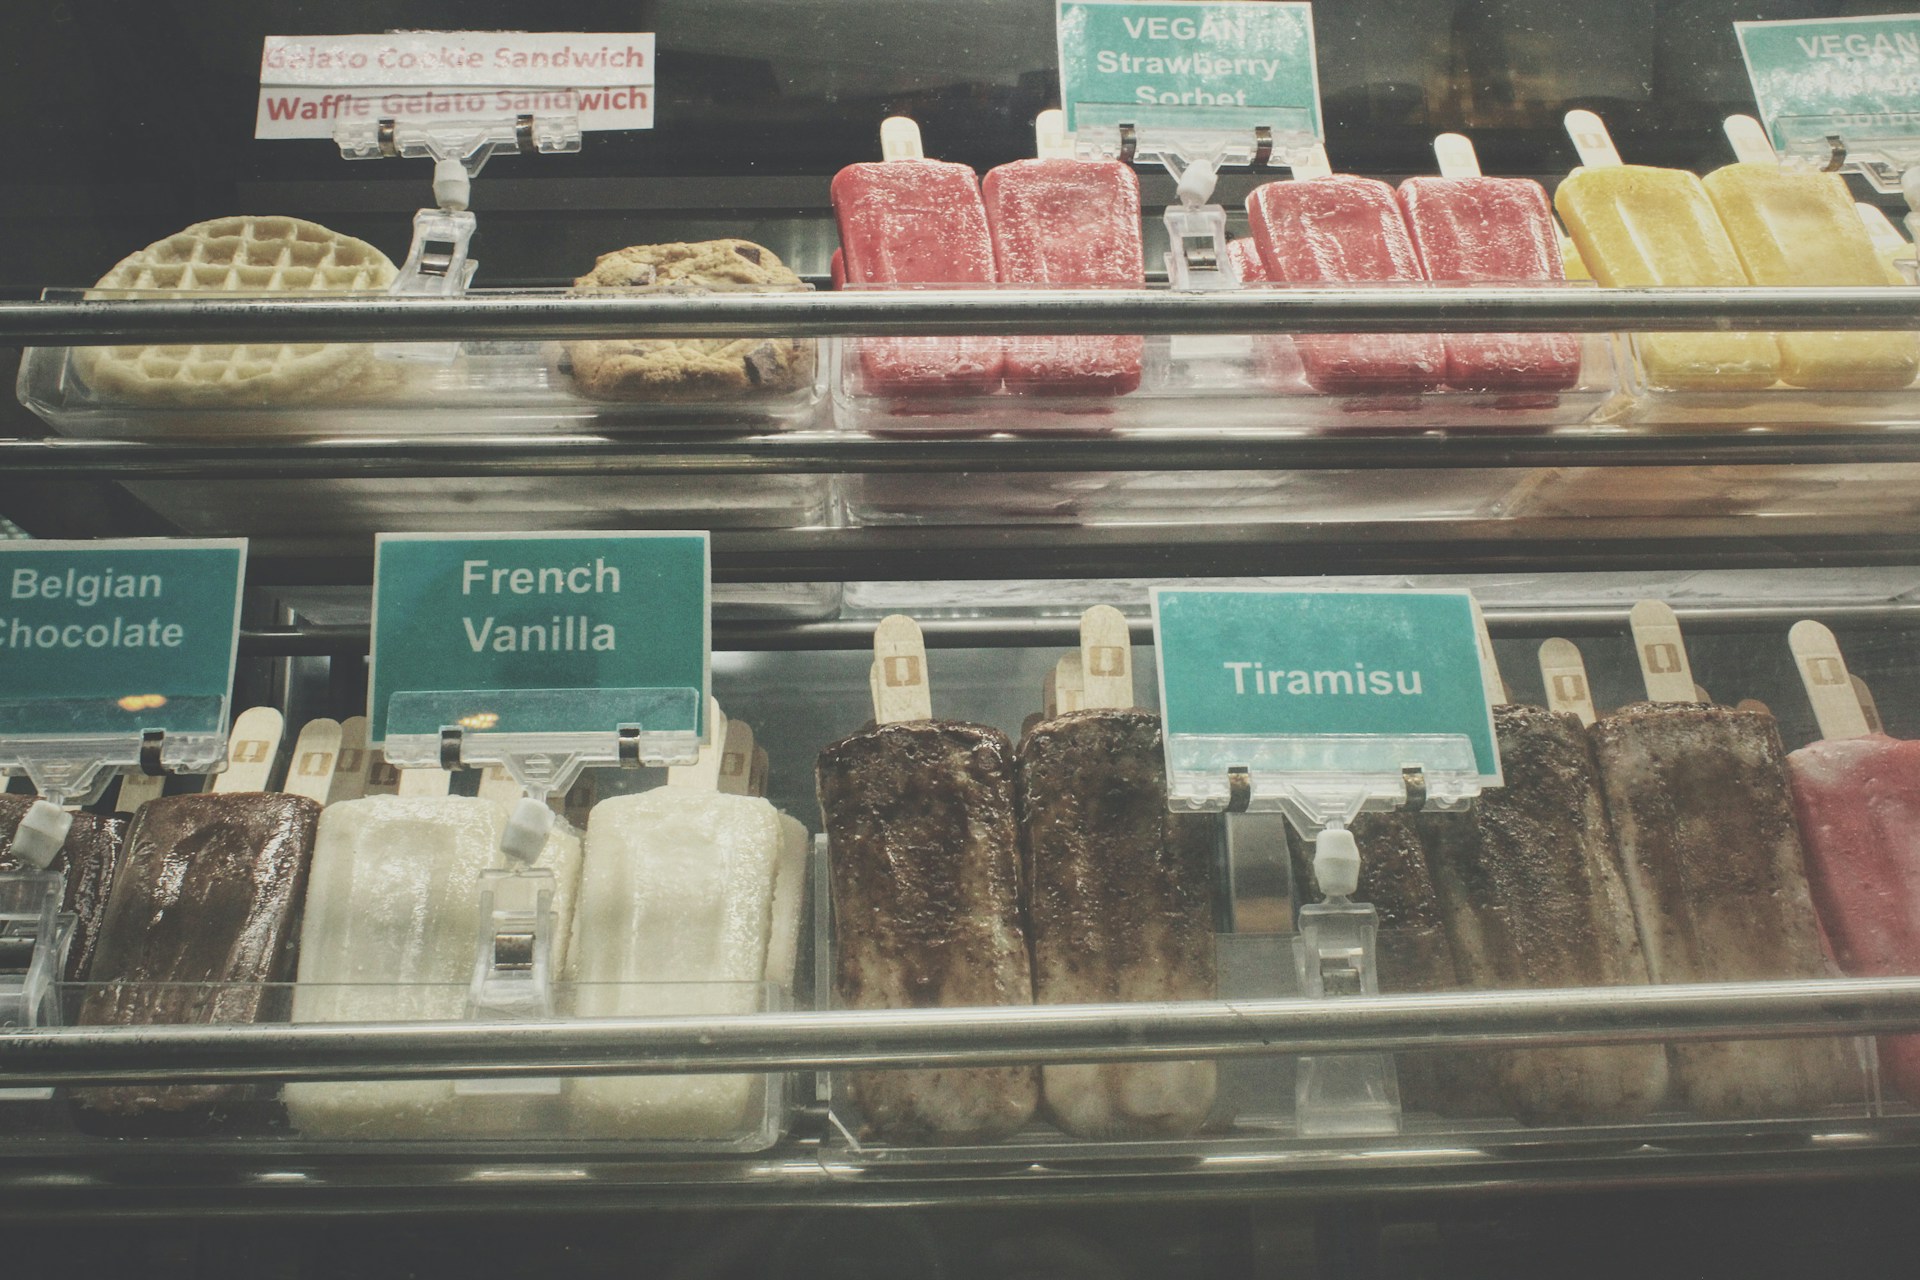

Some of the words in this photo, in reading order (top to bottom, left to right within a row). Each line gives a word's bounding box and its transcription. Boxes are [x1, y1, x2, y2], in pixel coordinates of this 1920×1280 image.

[1123, 17, 1247, 40] VEGAN
[265, 47, 368, 69] Gelato
[378, 46, 484, 69] Cookie
[494, 46, 643, 69] Sandwich
[1797, 32, 1920, 58] VEGAN
[1097, 50, 1279, 82] Strawberry
[267, 93, 370, 120] Waffle
[381, 91, 485, 115] Gelato
[495, 86, 647, 112] Sandwich
[1135, 85, 1246, 106] Sorbet
[11, 568, 162, 606] Belgian
[462, 557, 620, 595] French
[463, 616, 617, 652] Vanilla
[1224, 662, 1422, 695] Tiramisu
